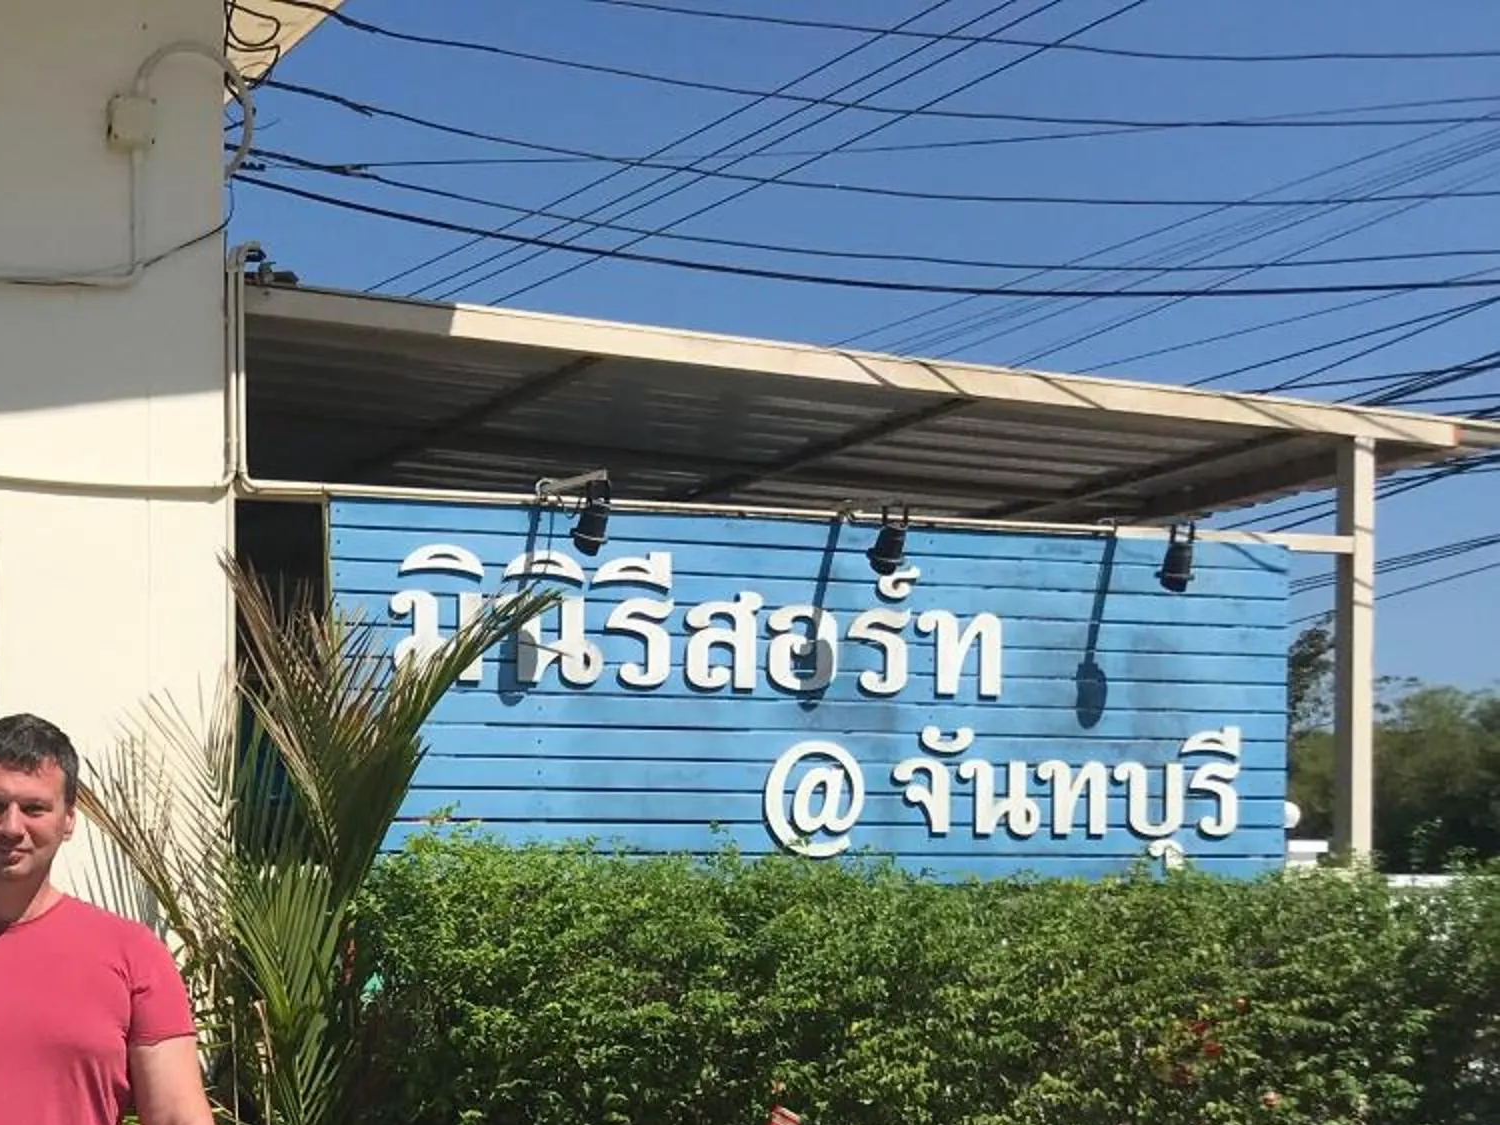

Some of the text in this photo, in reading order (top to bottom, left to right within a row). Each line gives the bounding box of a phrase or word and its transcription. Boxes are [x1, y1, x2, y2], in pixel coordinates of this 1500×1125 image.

[388, 544, 1002, 696] มินิรีสอร์ท
[764, 726, 1241, 870] @ จันทบุรี
